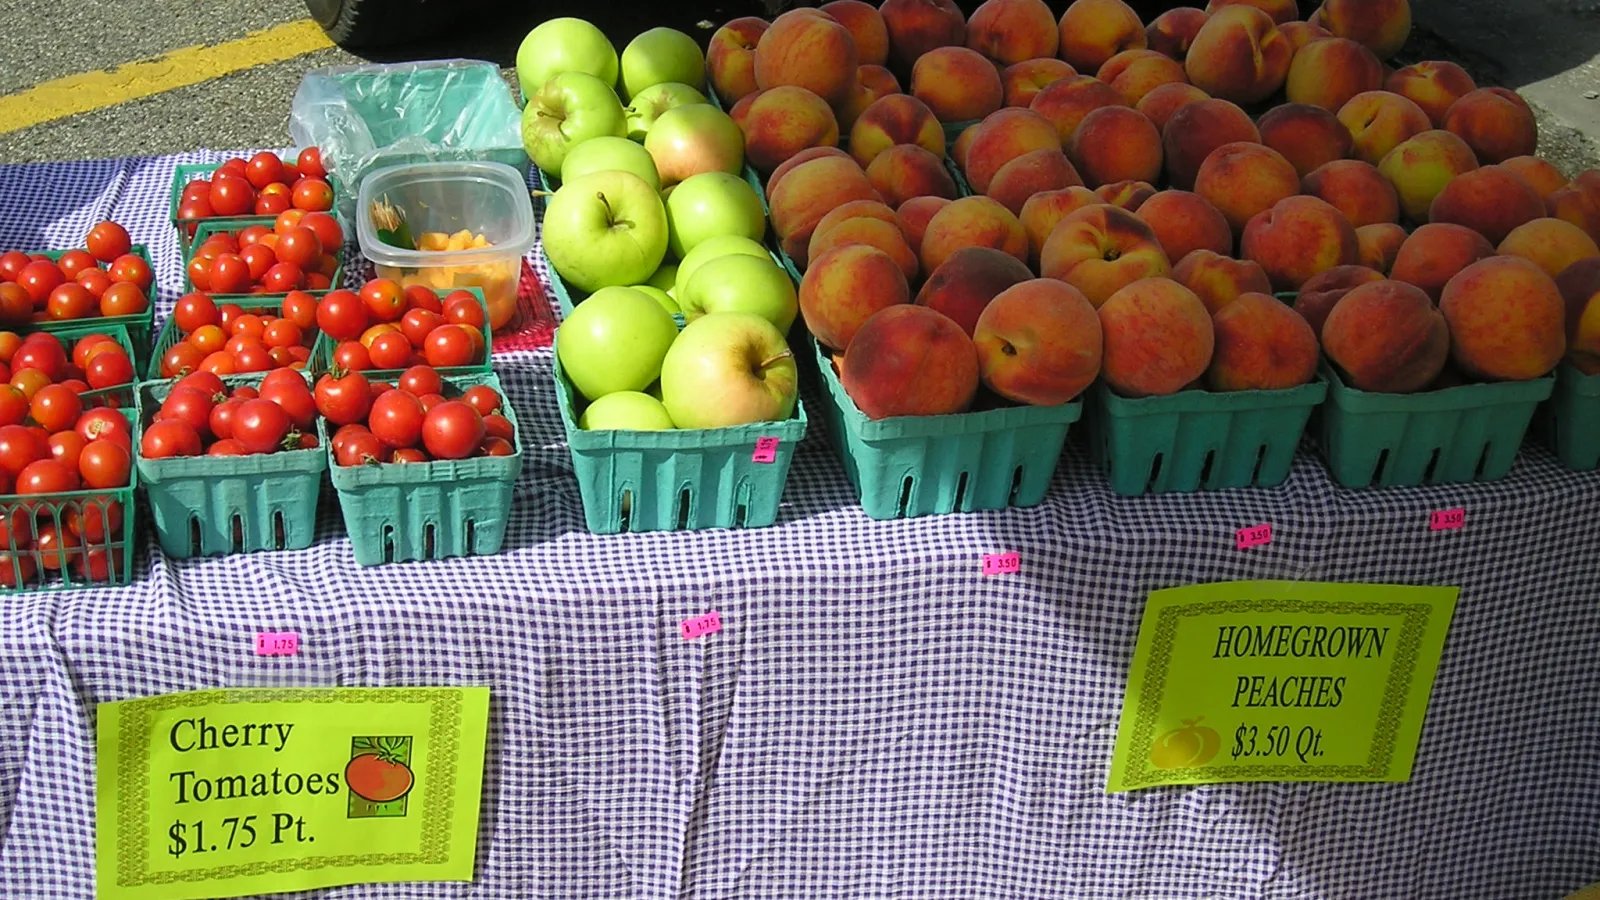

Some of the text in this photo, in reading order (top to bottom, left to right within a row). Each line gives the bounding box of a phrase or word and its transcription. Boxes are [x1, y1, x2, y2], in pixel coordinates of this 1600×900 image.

[997, 557, 1017, 569] 3.50
[697, 617, 717, 631] 1.75
[274, 639, 294, 649] 1.75
[1212, 625, 1390, 659] HOMEGROWN
[1231, 675, 1346, 708] PEACHES
[169, 717, 295, 753] Cherry
[1231, 722, 1325, 764] $3.50 Qt.
[169, 766, 341, 805] Tomatoes
[168, 812, 316, 859] $1.75 Pt.
